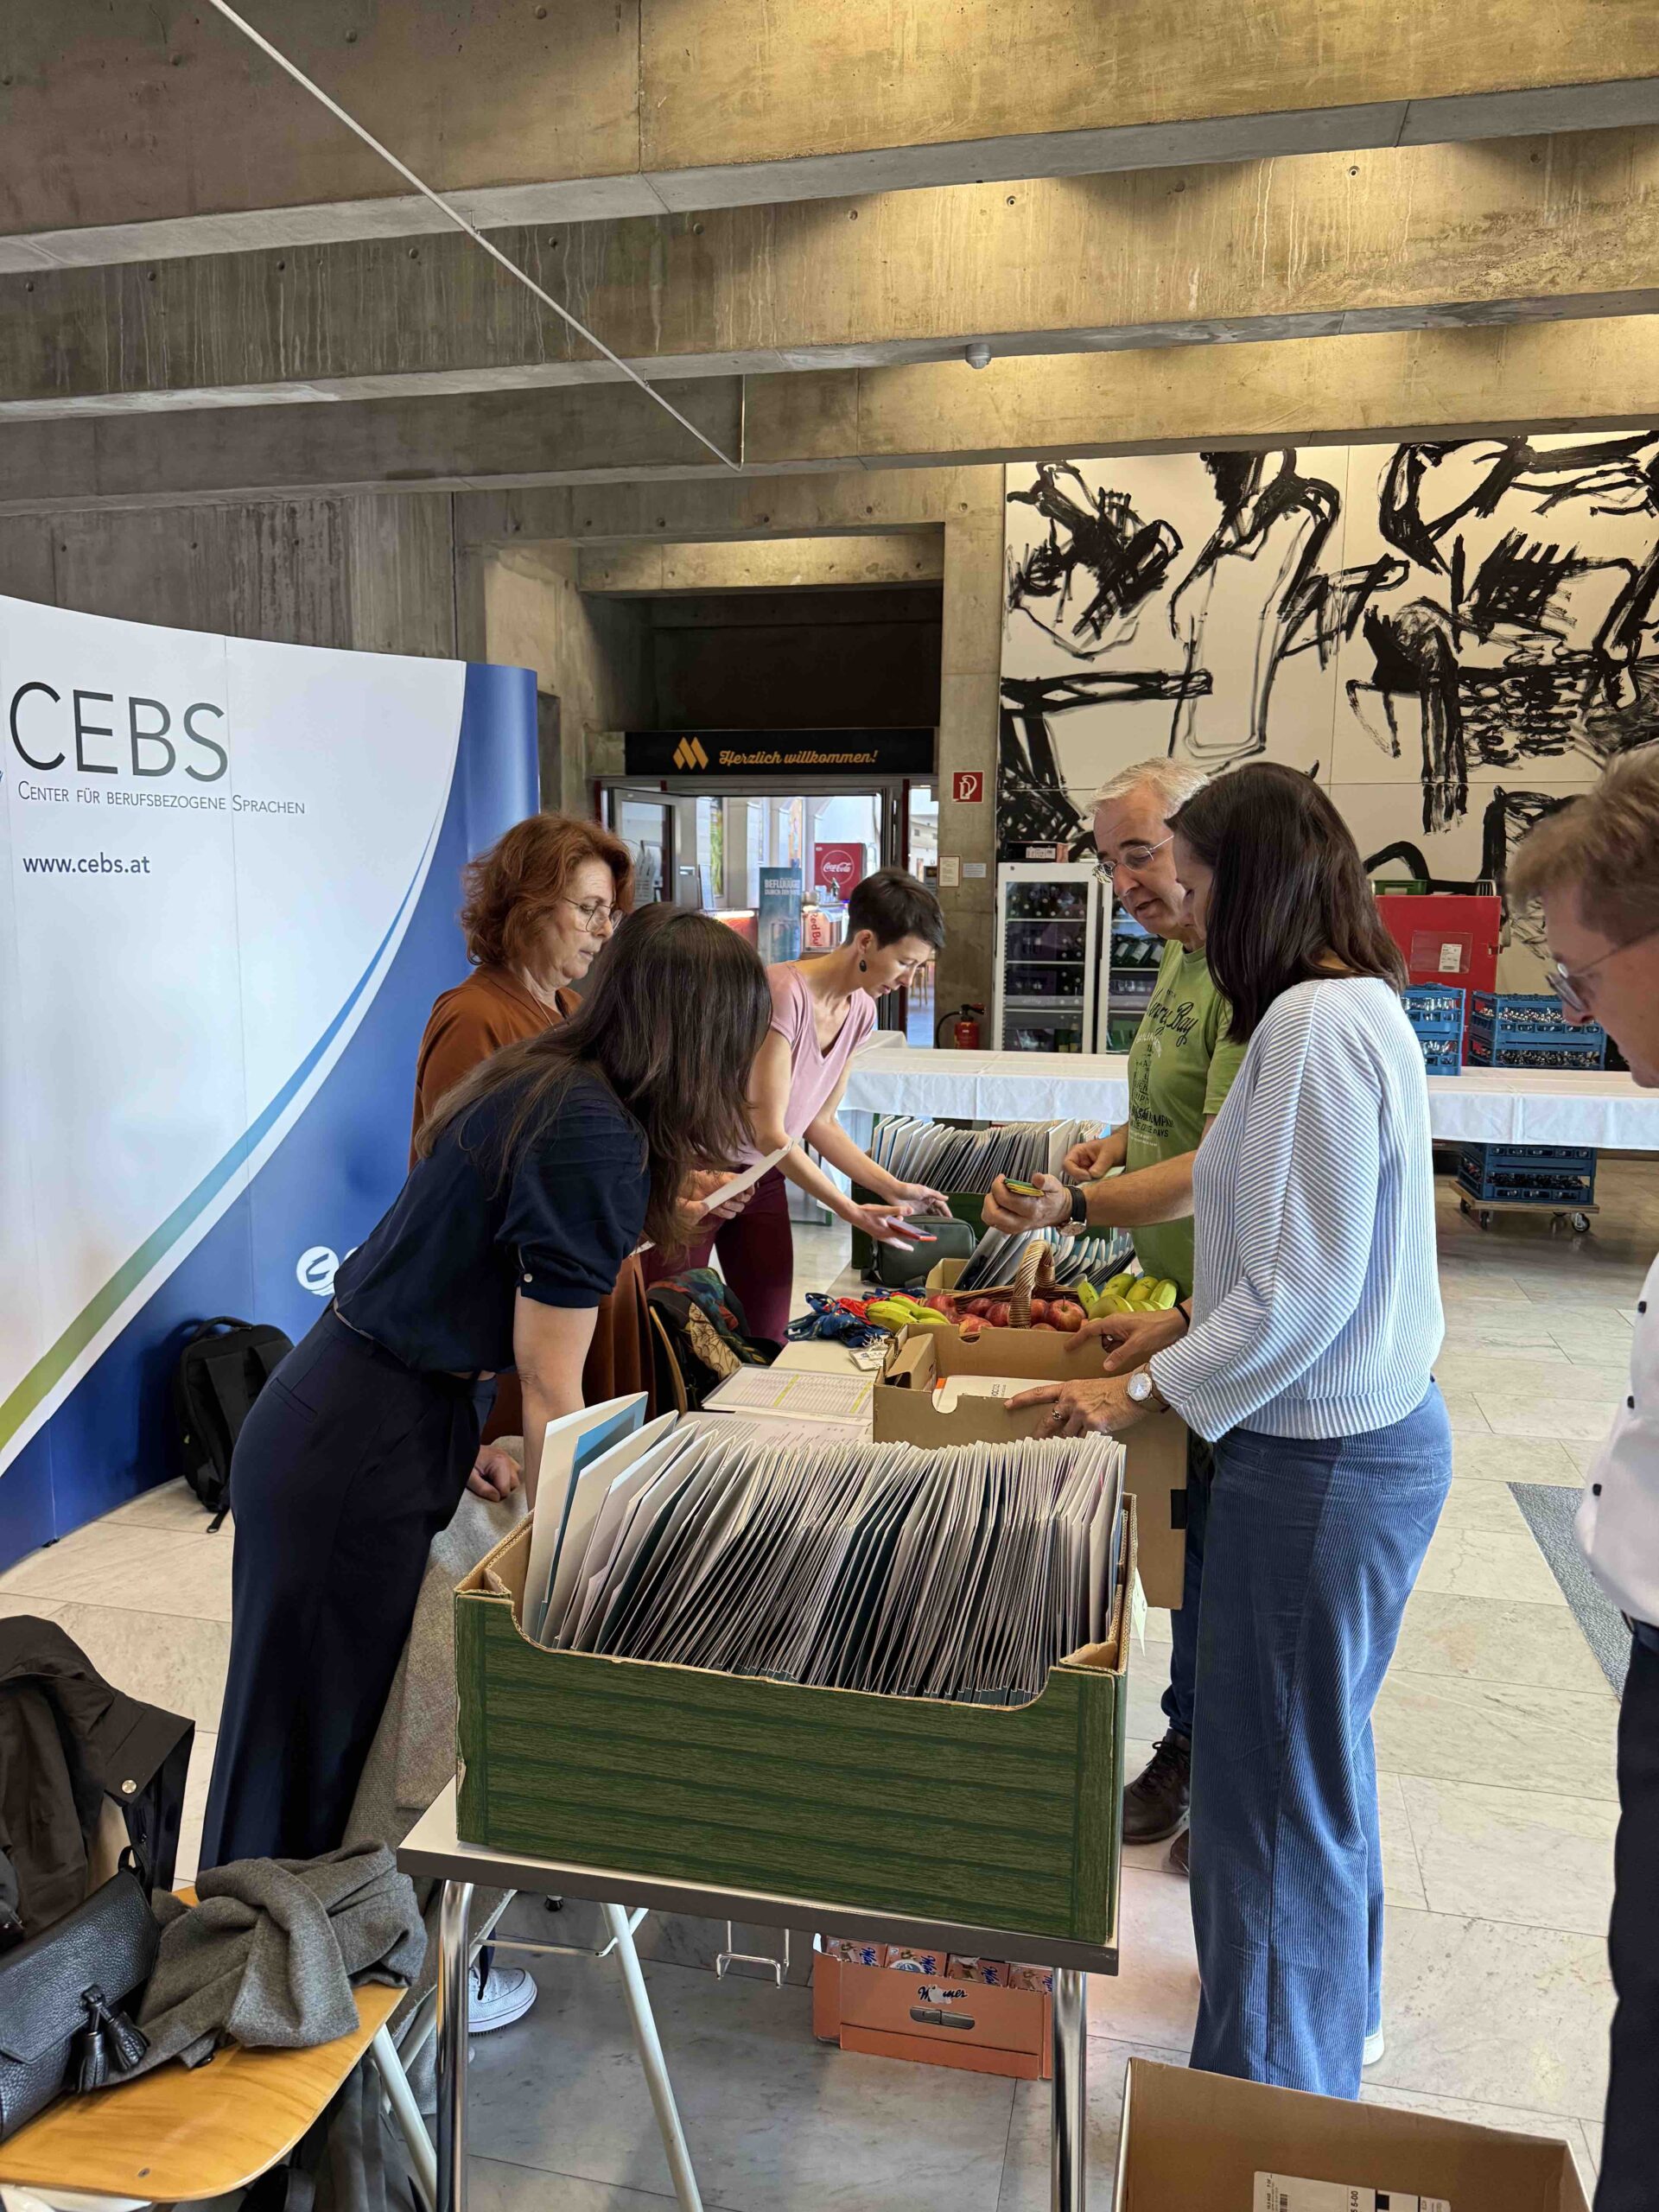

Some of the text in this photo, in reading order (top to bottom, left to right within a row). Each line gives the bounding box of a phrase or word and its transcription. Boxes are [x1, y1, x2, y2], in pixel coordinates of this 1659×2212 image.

[10, 681, 228, 783] CEBS
[719, 750, 879, 766] Herzlich willkommen!
[18, 780, 305, 815] CENTER FÜR BERUFSBEZOGENE SPRACHEN
[23, 851, 150, 874] www.cebs.at
